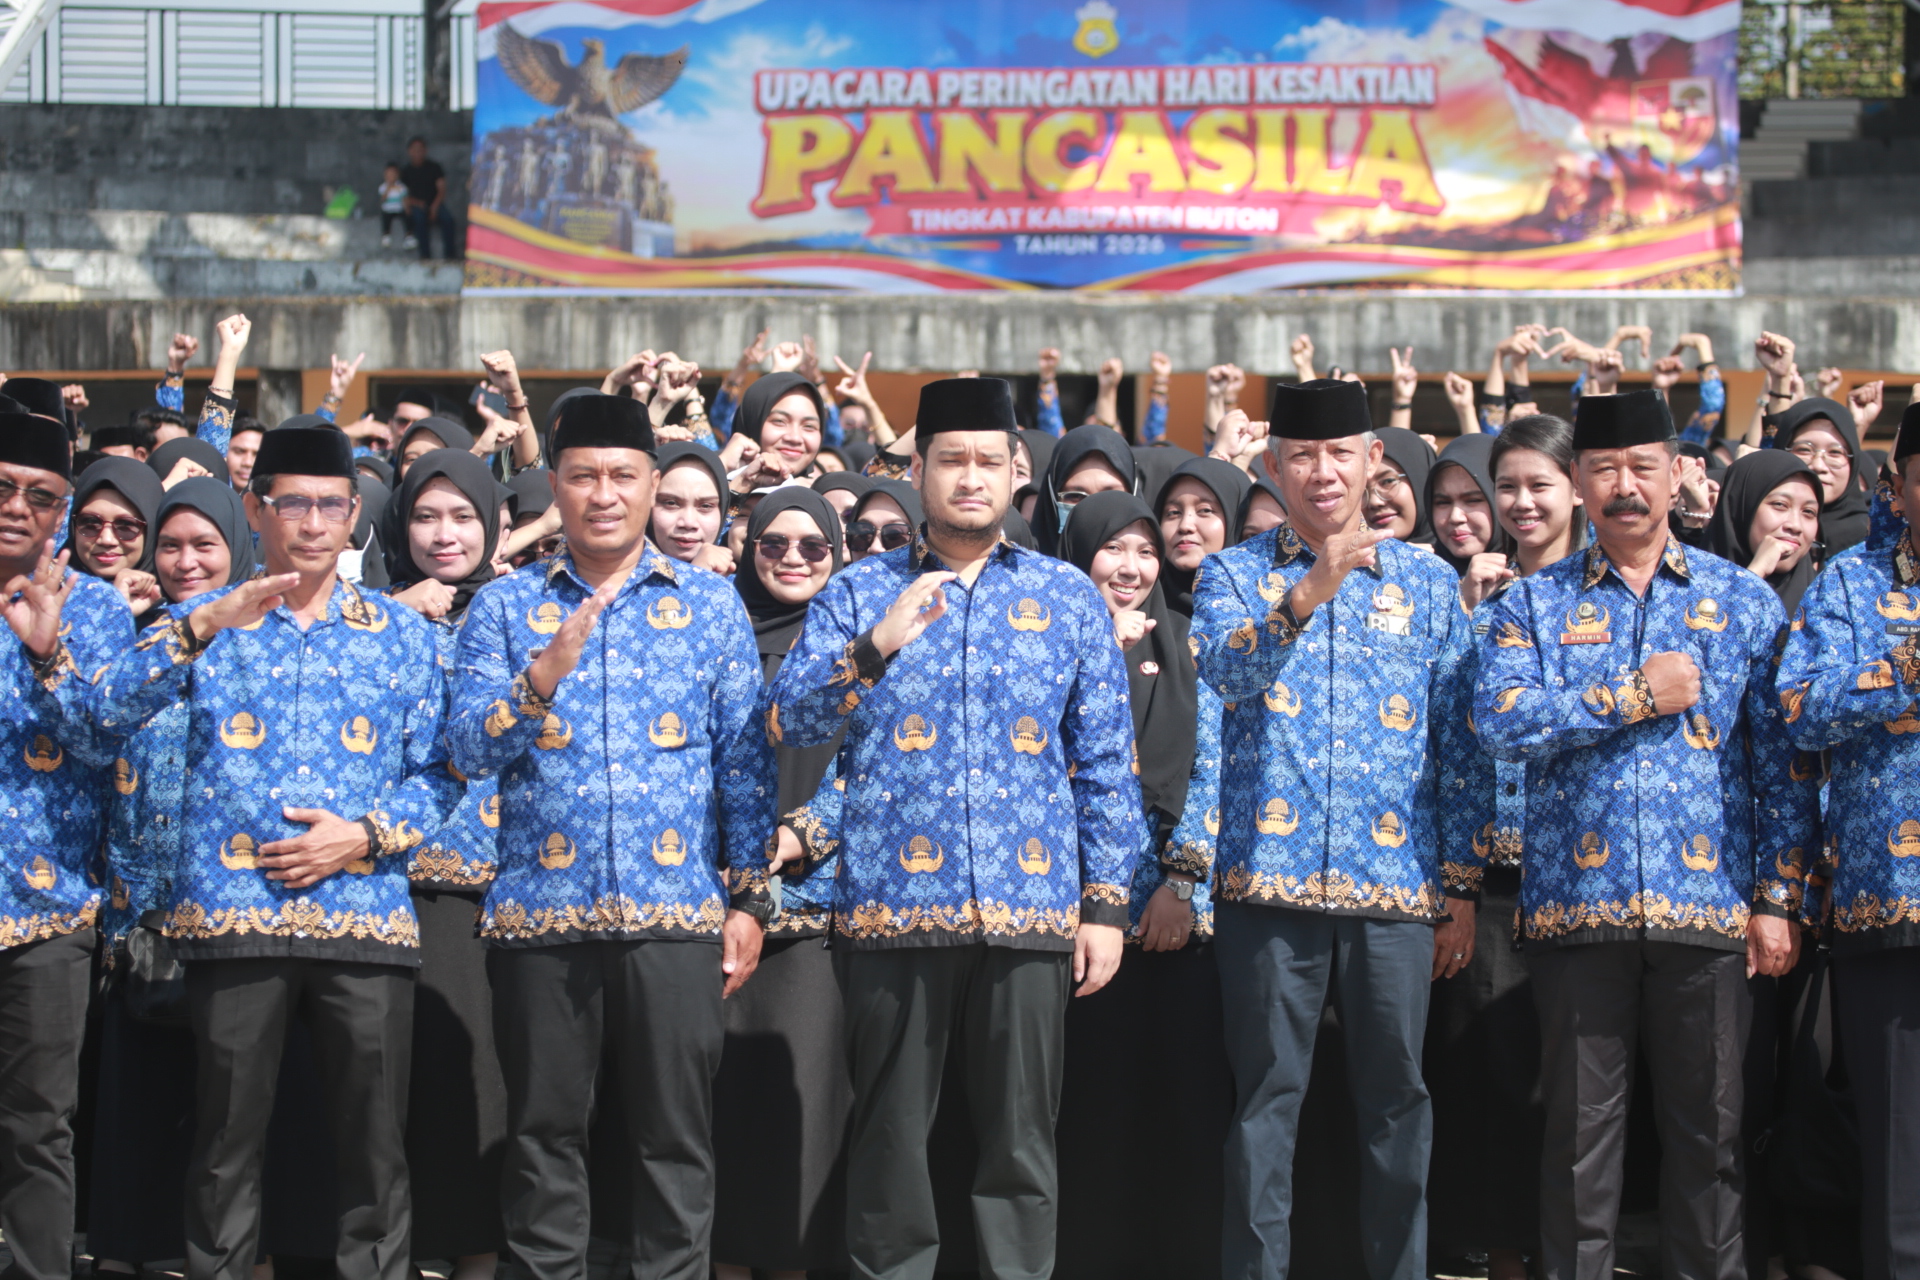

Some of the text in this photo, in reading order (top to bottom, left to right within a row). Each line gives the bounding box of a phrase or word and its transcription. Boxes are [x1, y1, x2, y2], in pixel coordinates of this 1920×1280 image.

[757, 65, 1435, 110] UPACARA PERINGATAN HARI KESAKTIAN
[752, 107, 1444, 210] PANCASILA
[908, 205, 1279, 231] TINGKAT KABUPATEN BUTON
[1014, 233, 1165, 255] TAHUN 2026
